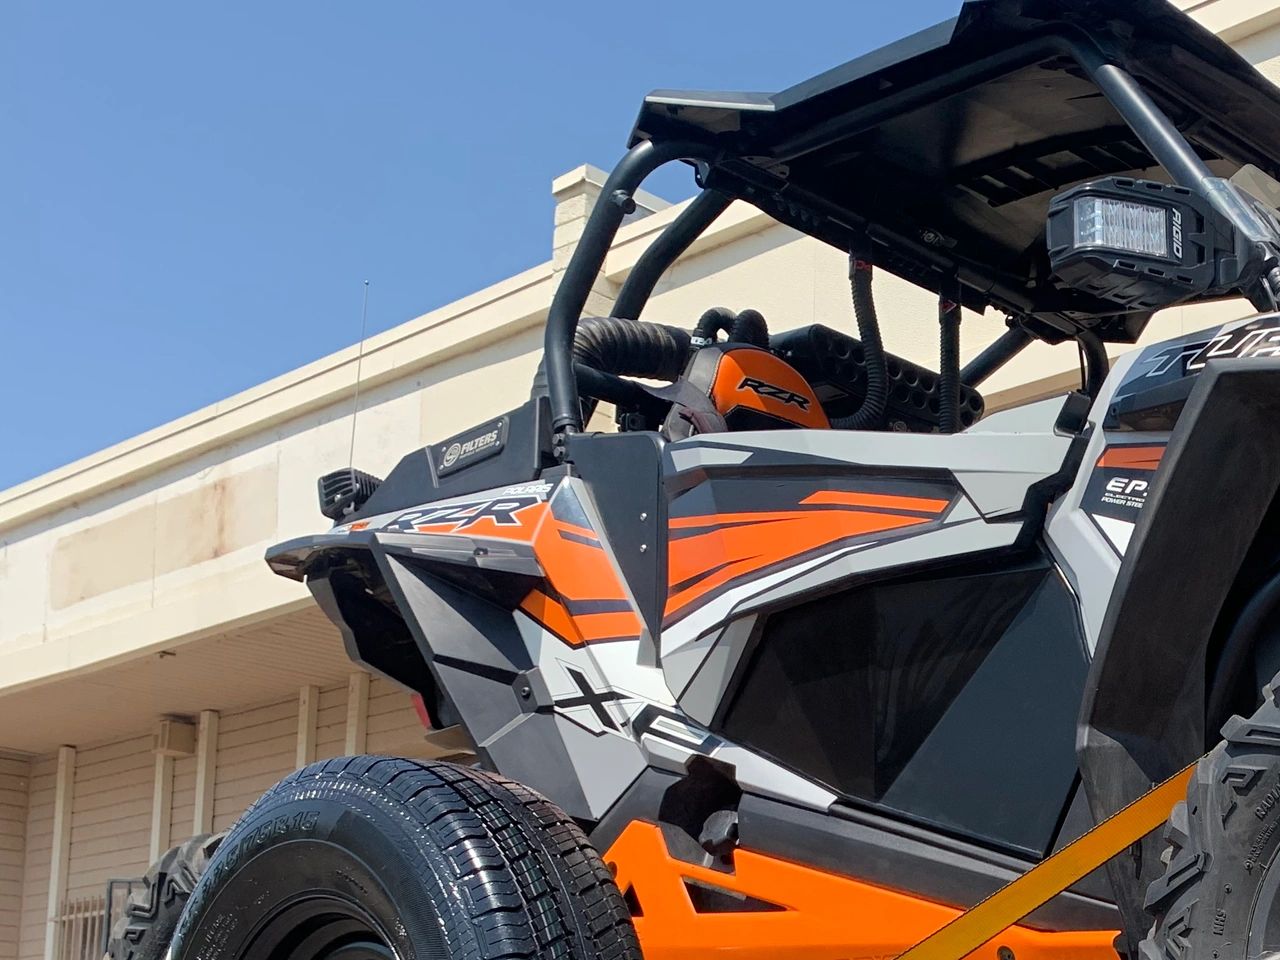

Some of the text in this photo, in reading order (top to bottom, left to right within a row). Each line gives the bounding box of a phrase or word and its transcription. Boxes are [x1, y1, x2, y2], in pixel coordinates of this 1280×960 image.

[1172, 207, 1182, 258] RIGID
[738, 377, 812, 412] RZR
[461, 430, 499, 455] FILTERS
[1106, 476, 1150, 497] EP
[380, 494, 543, 534] RZR
